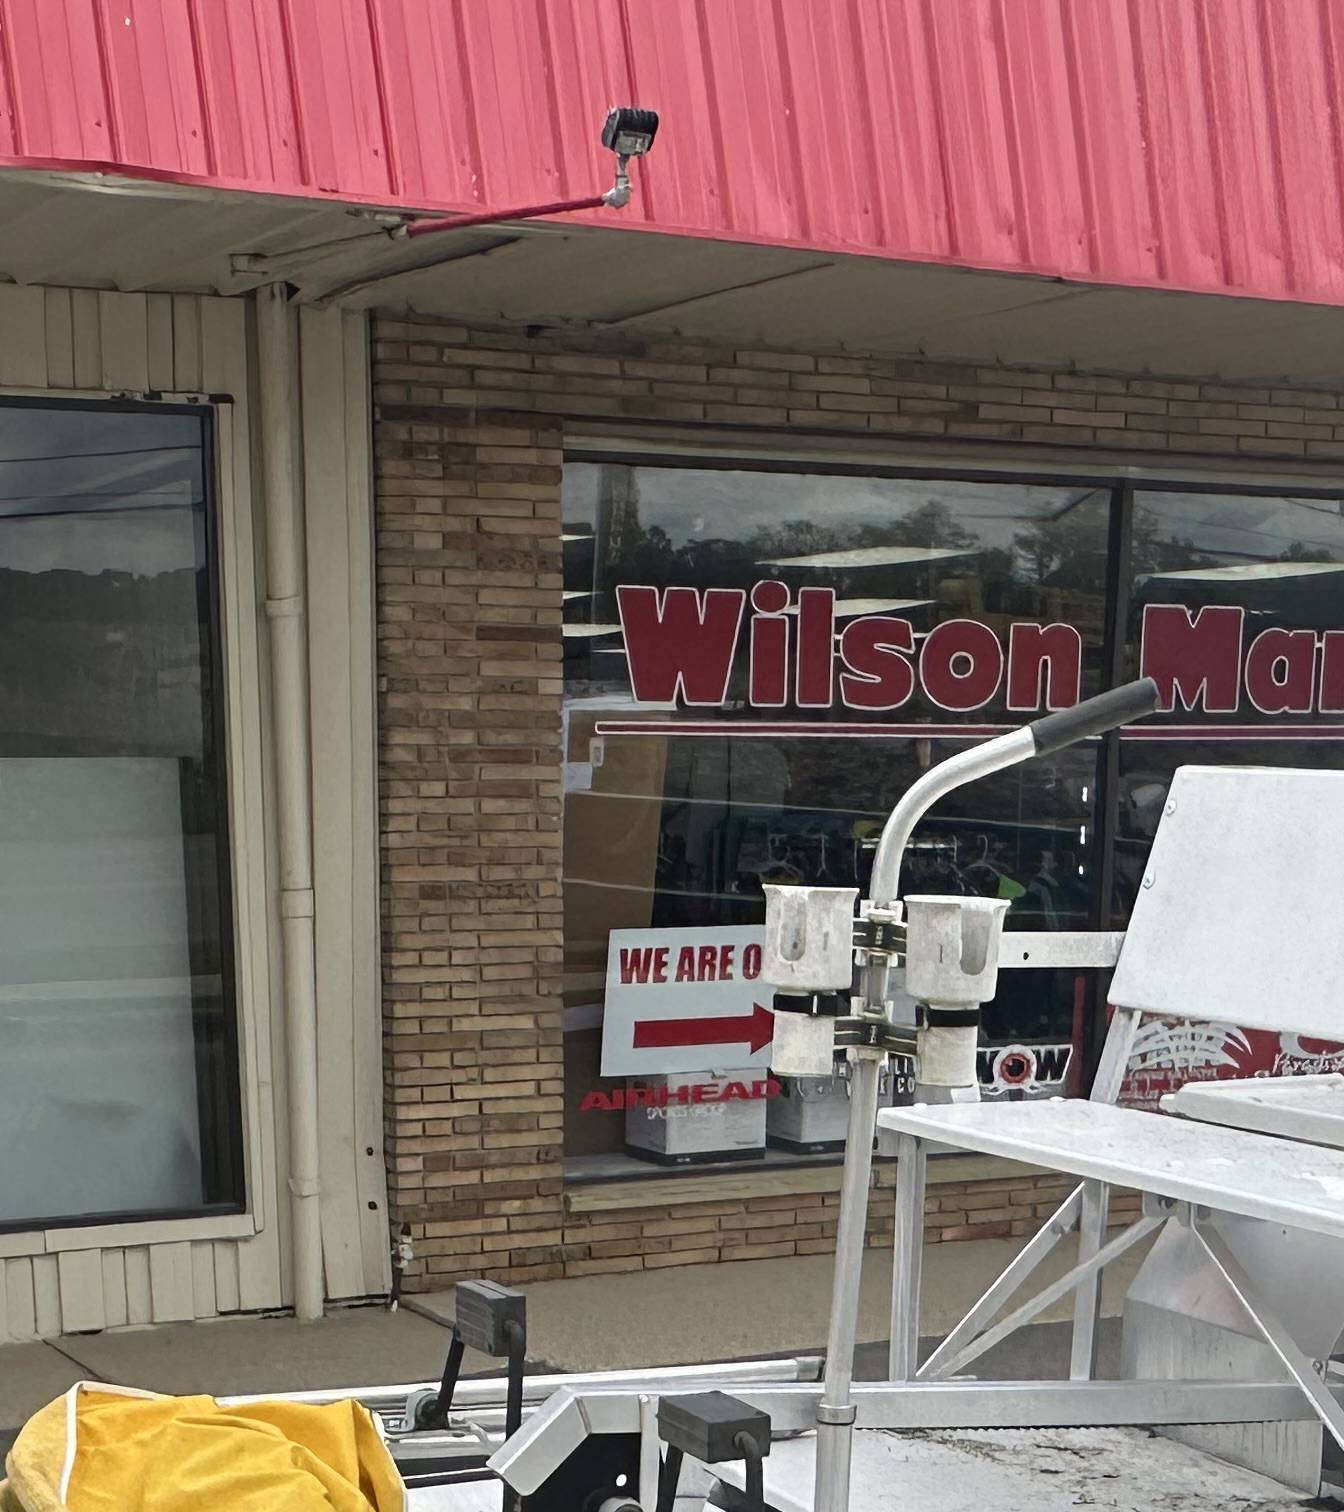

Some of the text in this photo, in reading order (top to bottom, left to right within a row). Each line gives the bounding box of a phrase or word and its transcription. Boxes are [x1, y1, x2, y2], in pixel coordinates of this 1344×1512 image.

[615, 579, 1082, 712] Wilson
[619, 947, 670, 984] WE
[674, 944, 735, 983] ARE
[579, 1078, 783, 1112] AIRHEAD
